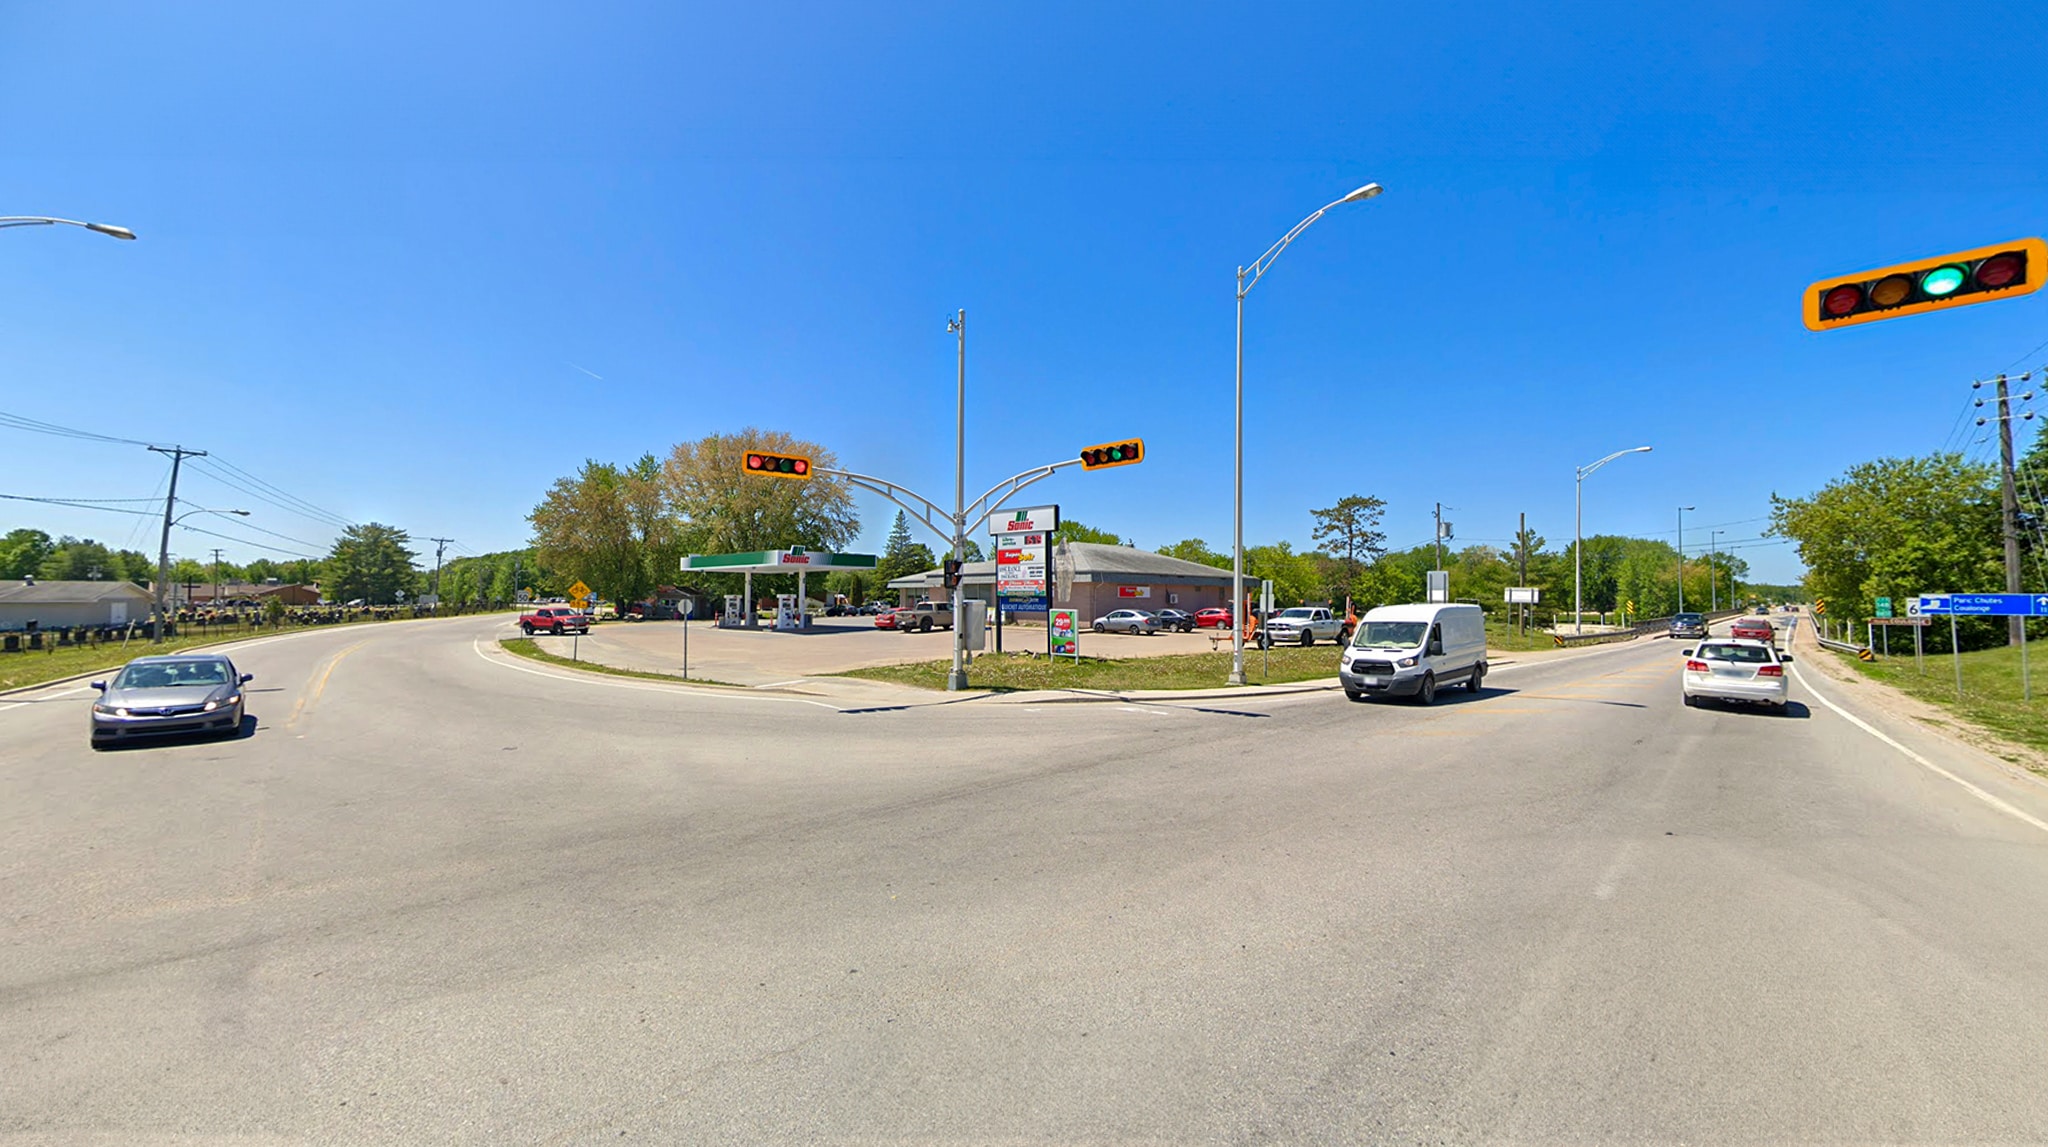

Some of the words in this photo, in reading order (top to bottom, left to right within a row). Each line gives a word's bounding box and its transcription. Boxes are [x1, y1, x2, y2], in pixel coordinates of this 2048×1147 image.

[1007, 518, 1034, 531] Sonic
[782, 553, 810, 564] Sonic
[519, 594, 528, 602] 50
[1909, 605, 1919, 615] 6
[1954, 605, 1990, 613] Coulonge
